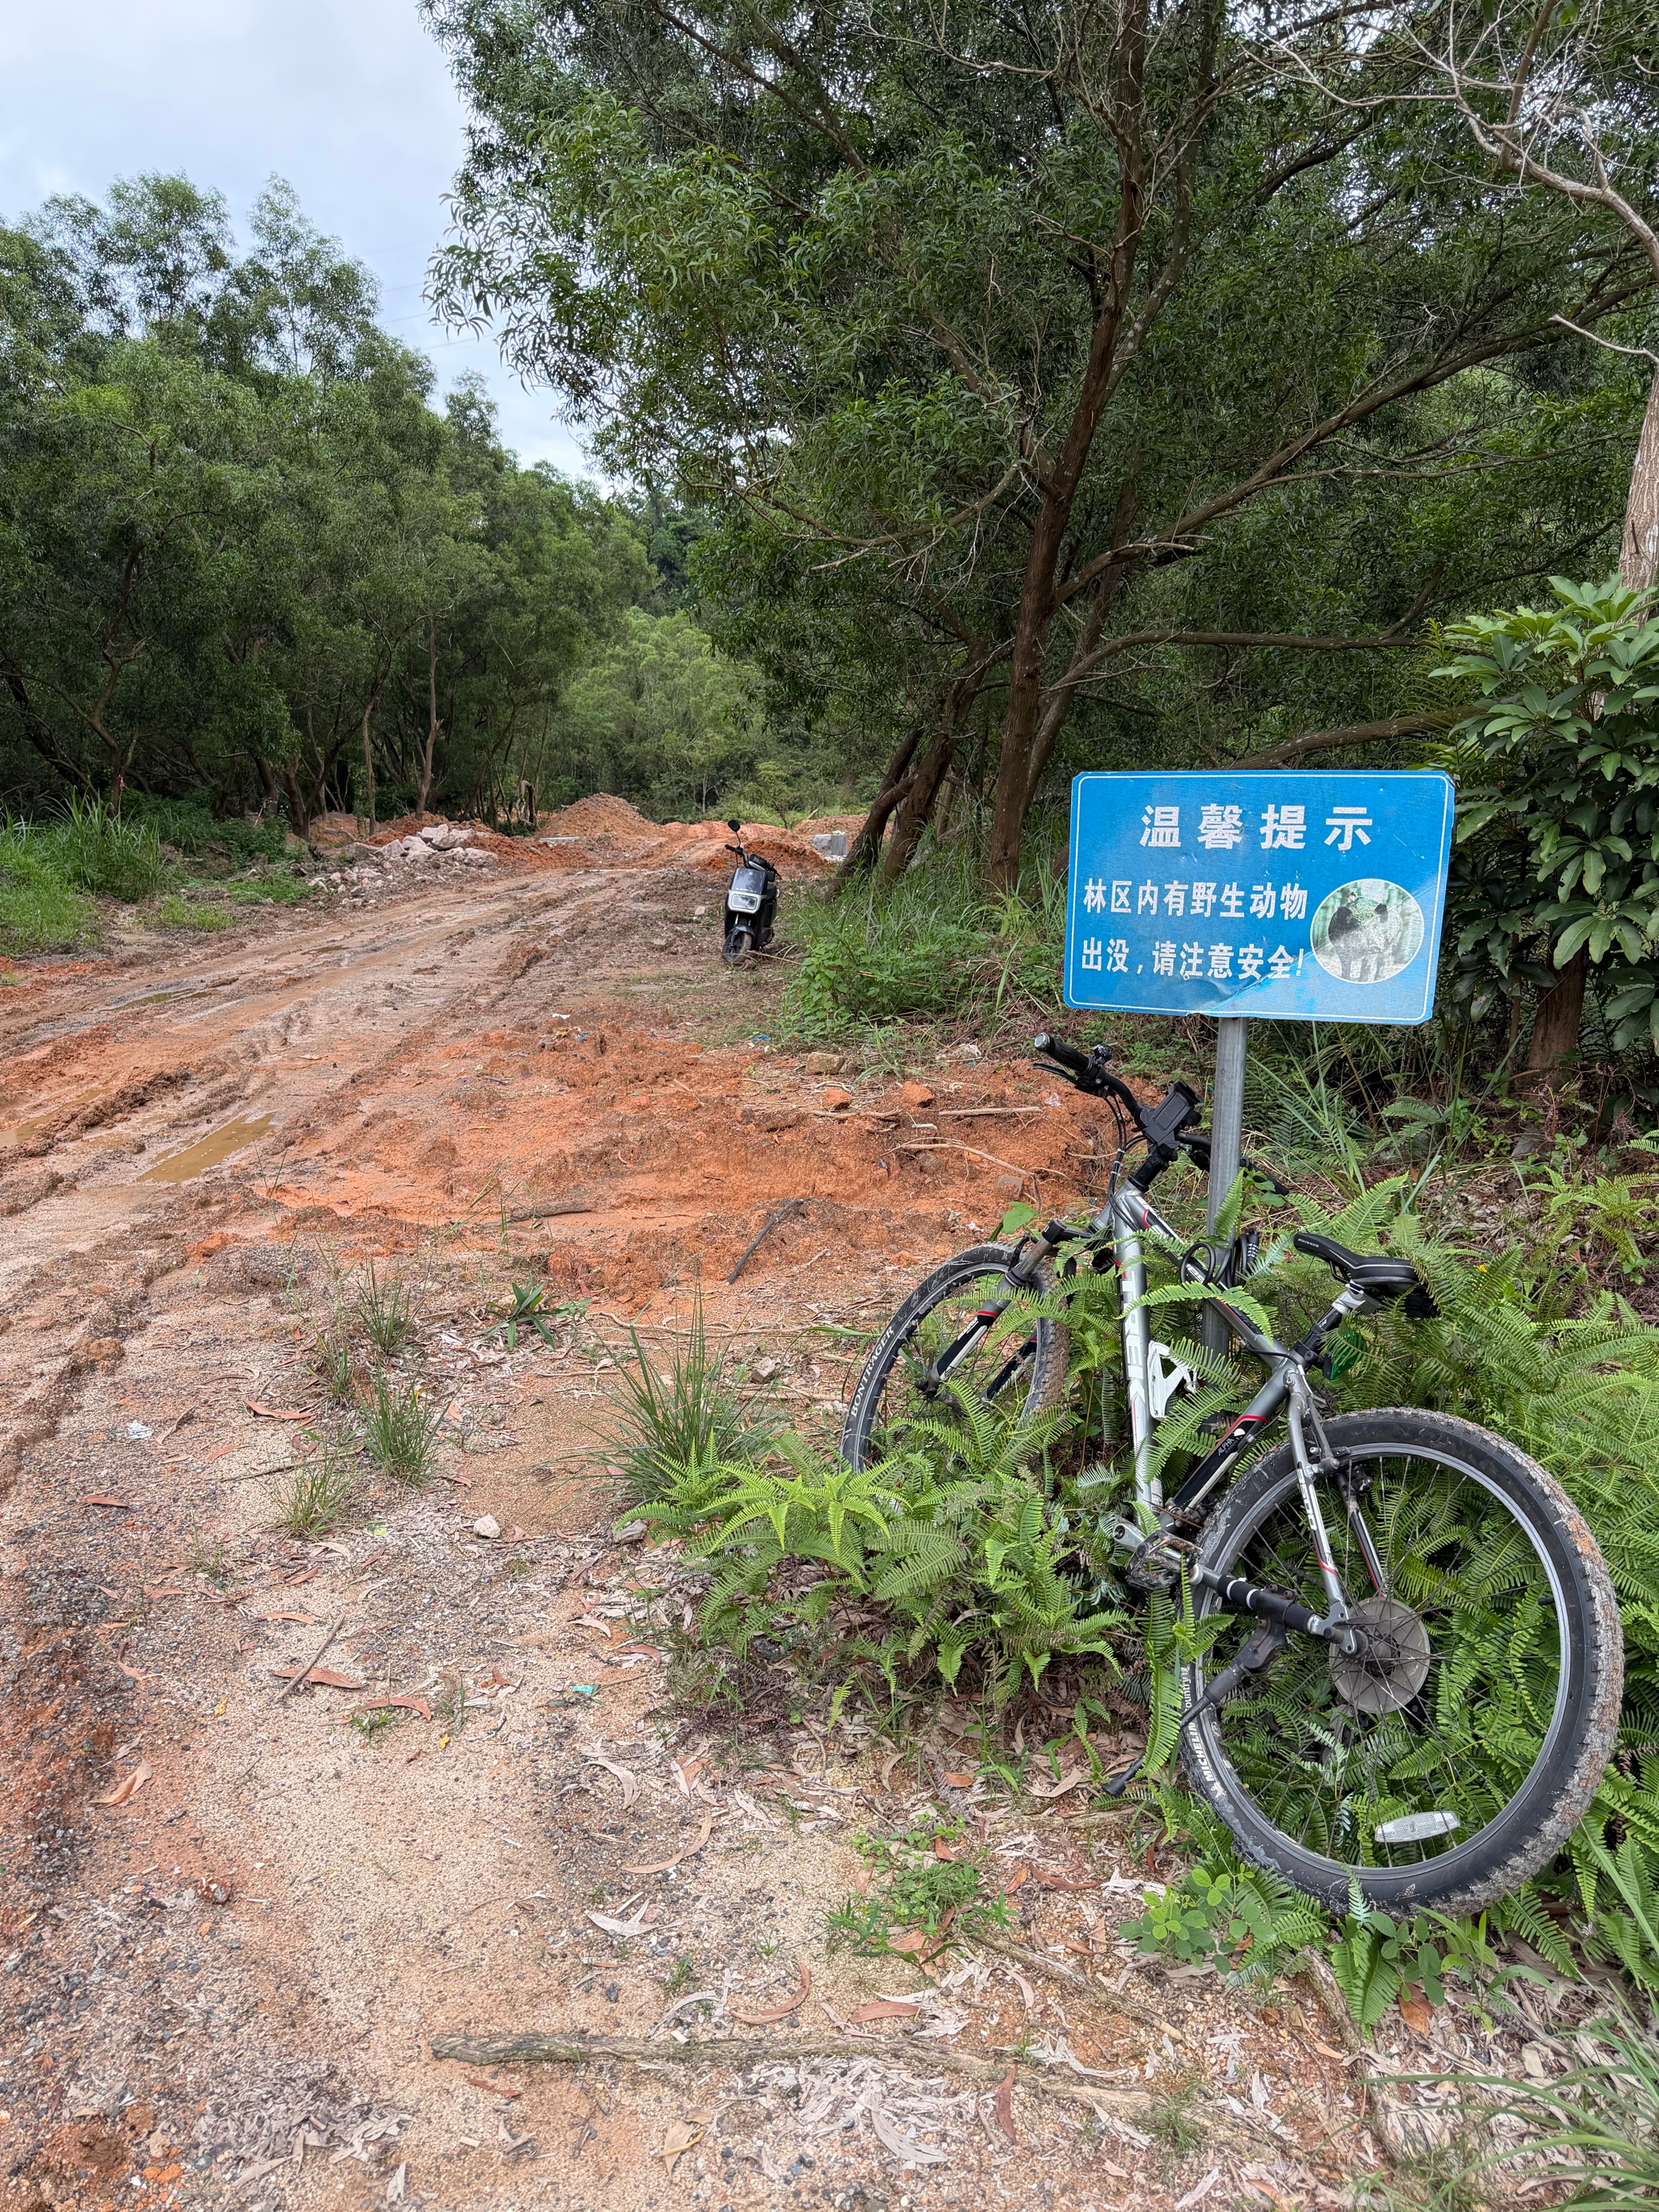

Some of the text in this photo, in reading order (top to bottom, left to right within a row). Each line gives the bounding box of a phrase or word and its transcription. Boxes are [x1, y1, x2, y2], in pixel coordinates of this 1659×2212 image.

[1139, 804, 1372, 850] 温馨提示
[1084, 878, 1308, 920] 林区内有野生动物
[850, 1326, 895, 1417] BONTRAGER
[1218, 1438, 1235, 1456] ALPHA
[1183, 1677, 1192, 1711] ountry
[1187, 1722, 1216, 1782] MICHELIN
